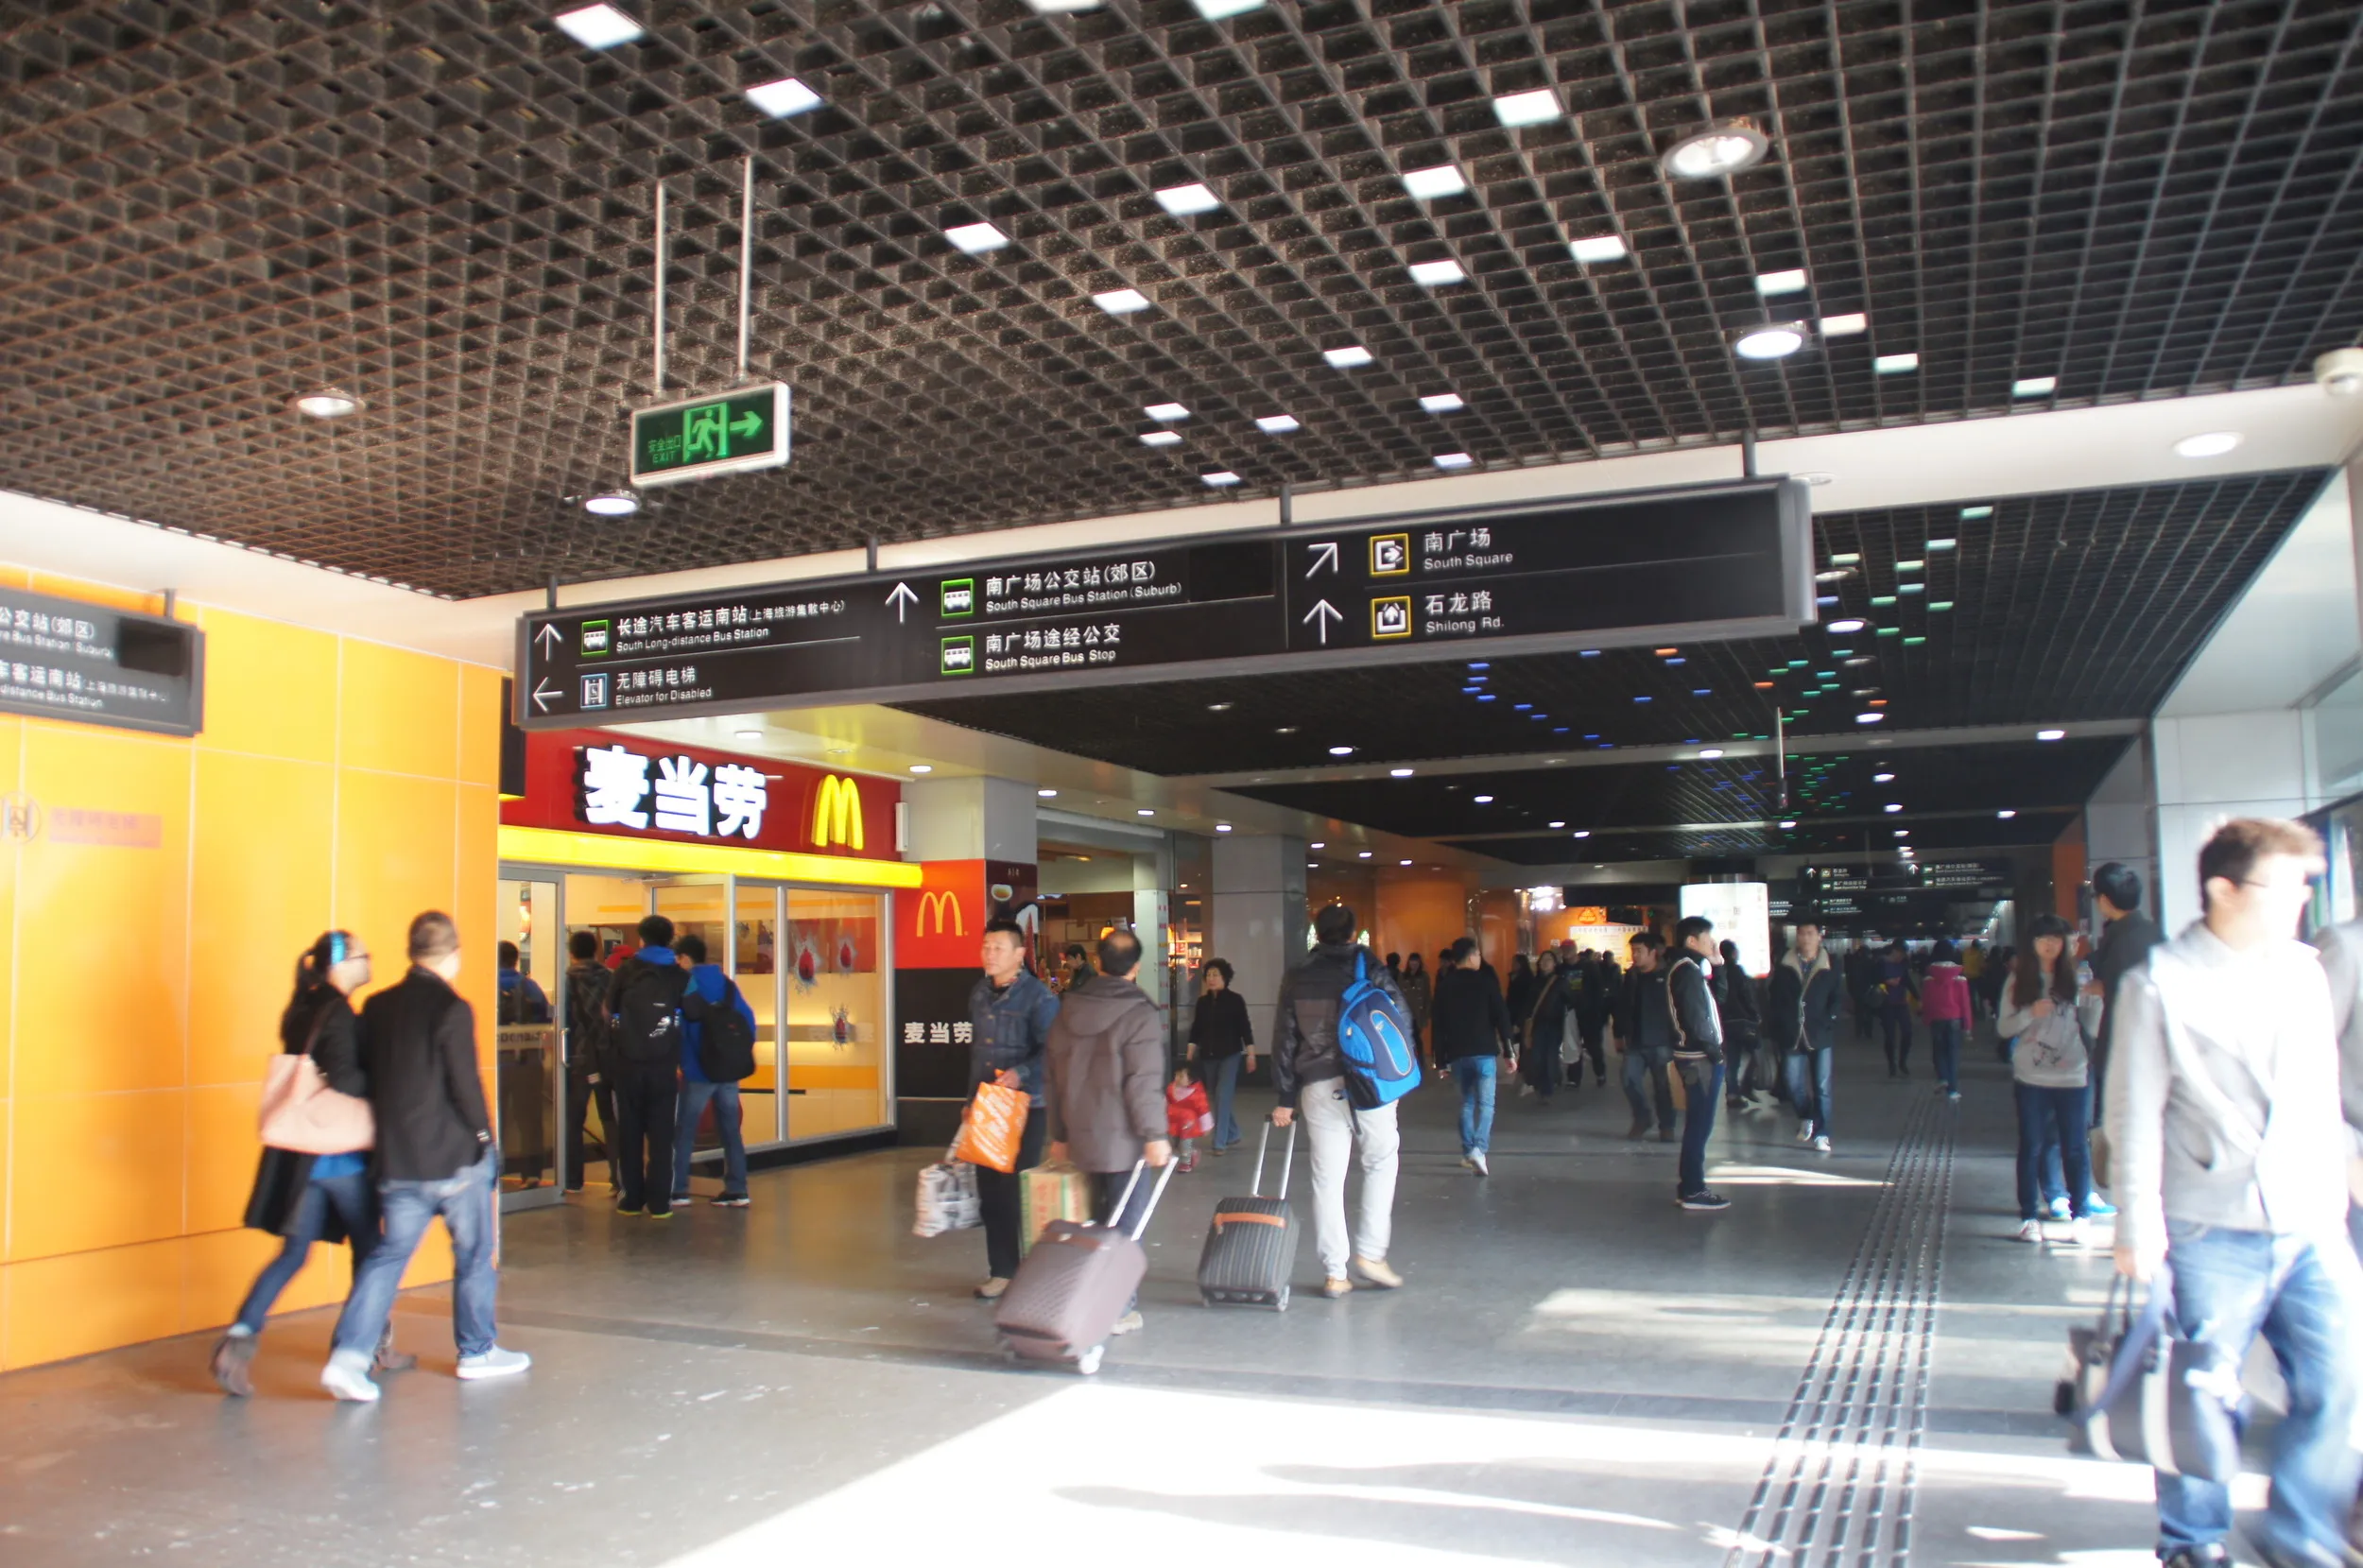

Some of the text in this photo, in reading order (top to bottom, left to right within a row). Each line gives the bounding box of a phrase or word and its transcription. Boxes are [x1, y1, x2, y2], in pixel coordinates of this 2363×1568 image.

[653, 452, 675, 463] EXIT
[1424, 527, 1491, 552] 南广场
[1423, 552, 1513, 570] South Square
[986, 560, 1156, 596] 南广场公交站(郊区)
[986, 582, 1182, 613] South Square Bus Station (Suburb)
[1425, 590, 1492, 615] 石龙路
[1426, 616, 1505, 633] Shilong Rd.
[11, 630, 32, 645] Bus
[34, 634, 71, 650] Station
[616, 627, 769, 654] South Long-distance Bus Station
[986, 623, 1121, 654] 南广场途经公交
[986, 648, 1116, 671] South Square Bus Stop
[616, 665, 696, 691] 无障碍电梯
[46, 689, 66, 703] Bus
[68, 691, 103, 708] Station
[615, 686, 712, 707] Elevator for Disabled
[582, 745, 768, 839] 麦当劳
[905, 1022, 973, 1043] 麦当劳
